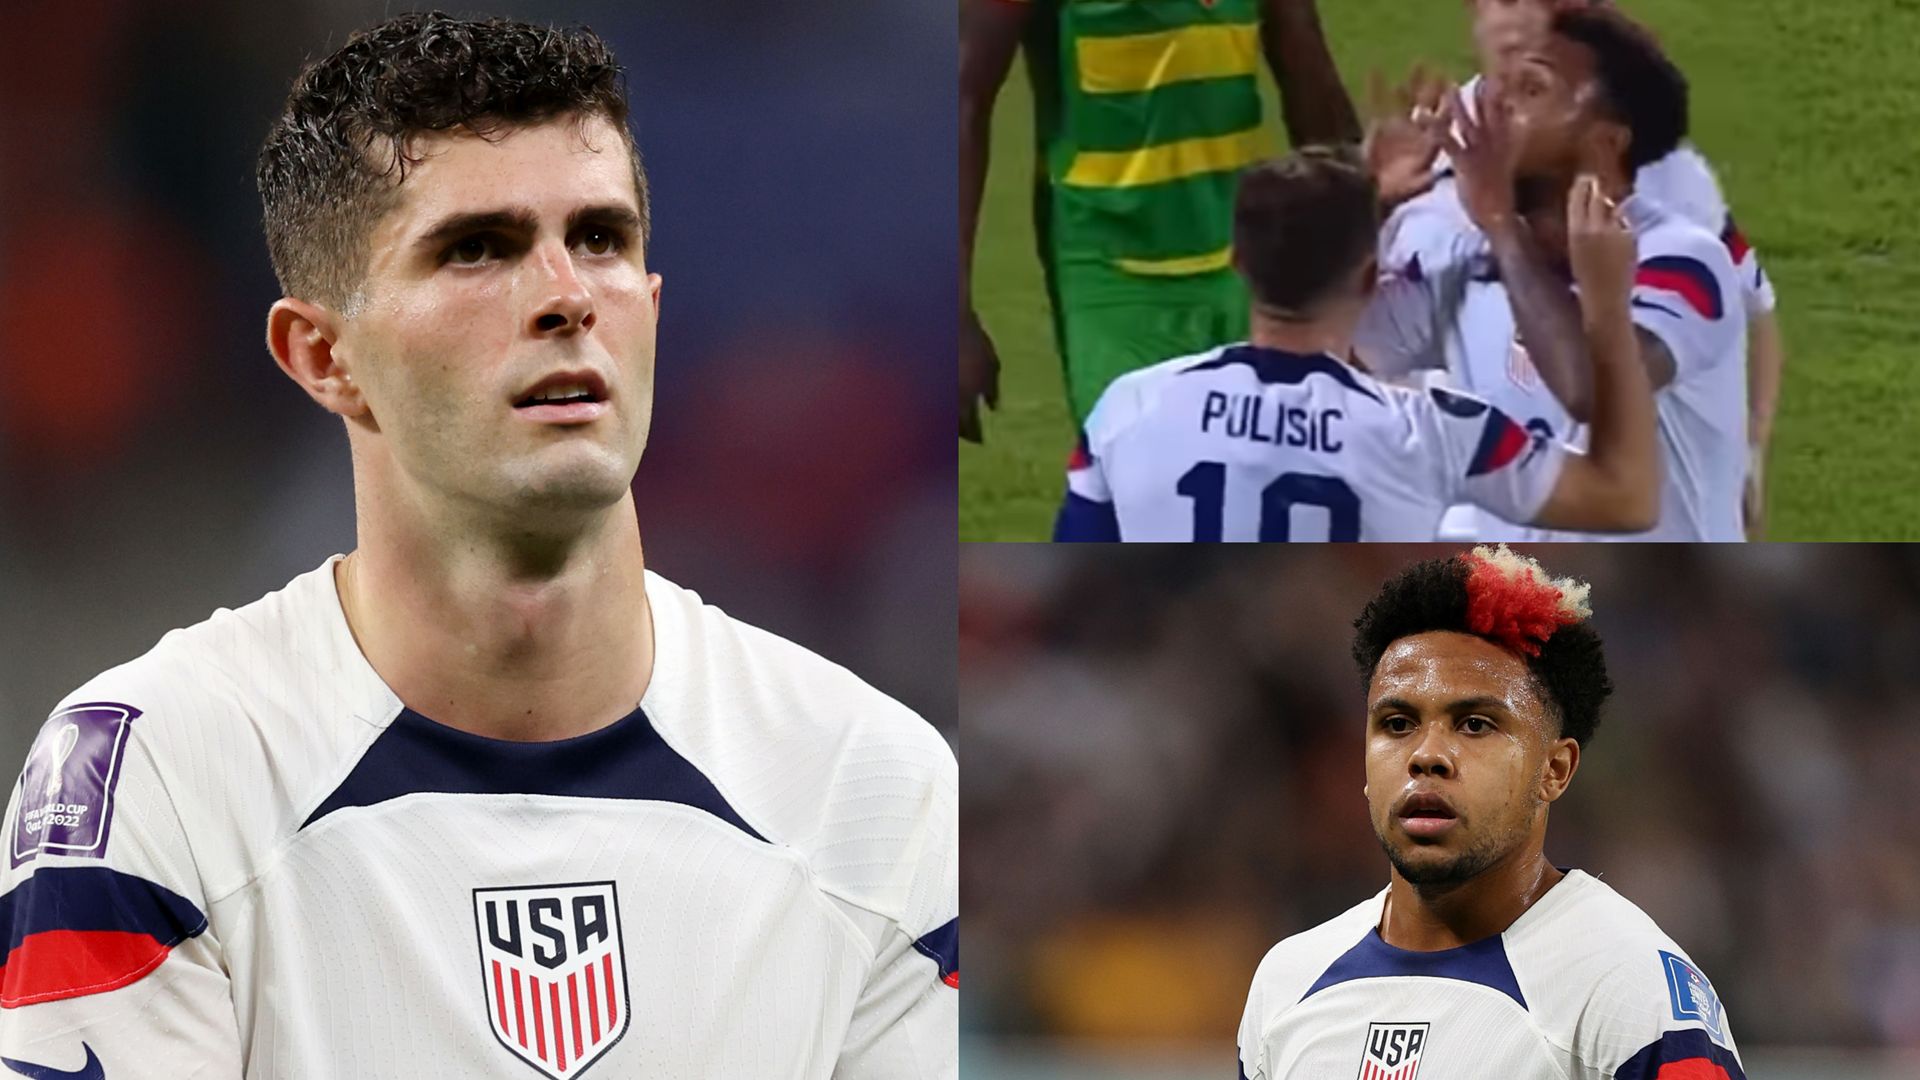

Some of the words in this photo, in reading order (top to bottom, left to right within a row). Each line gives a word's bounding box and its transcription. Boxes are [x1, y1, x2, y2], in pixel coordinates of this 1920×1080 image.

[1202, 391, 1343, 454] PULISIC
[47, 813, 79, 827] 2022
[66, 804, 88, 814] CUP
[485, 894, 609, 970] USA
[1370, 1029, 1424, 1068] USA
